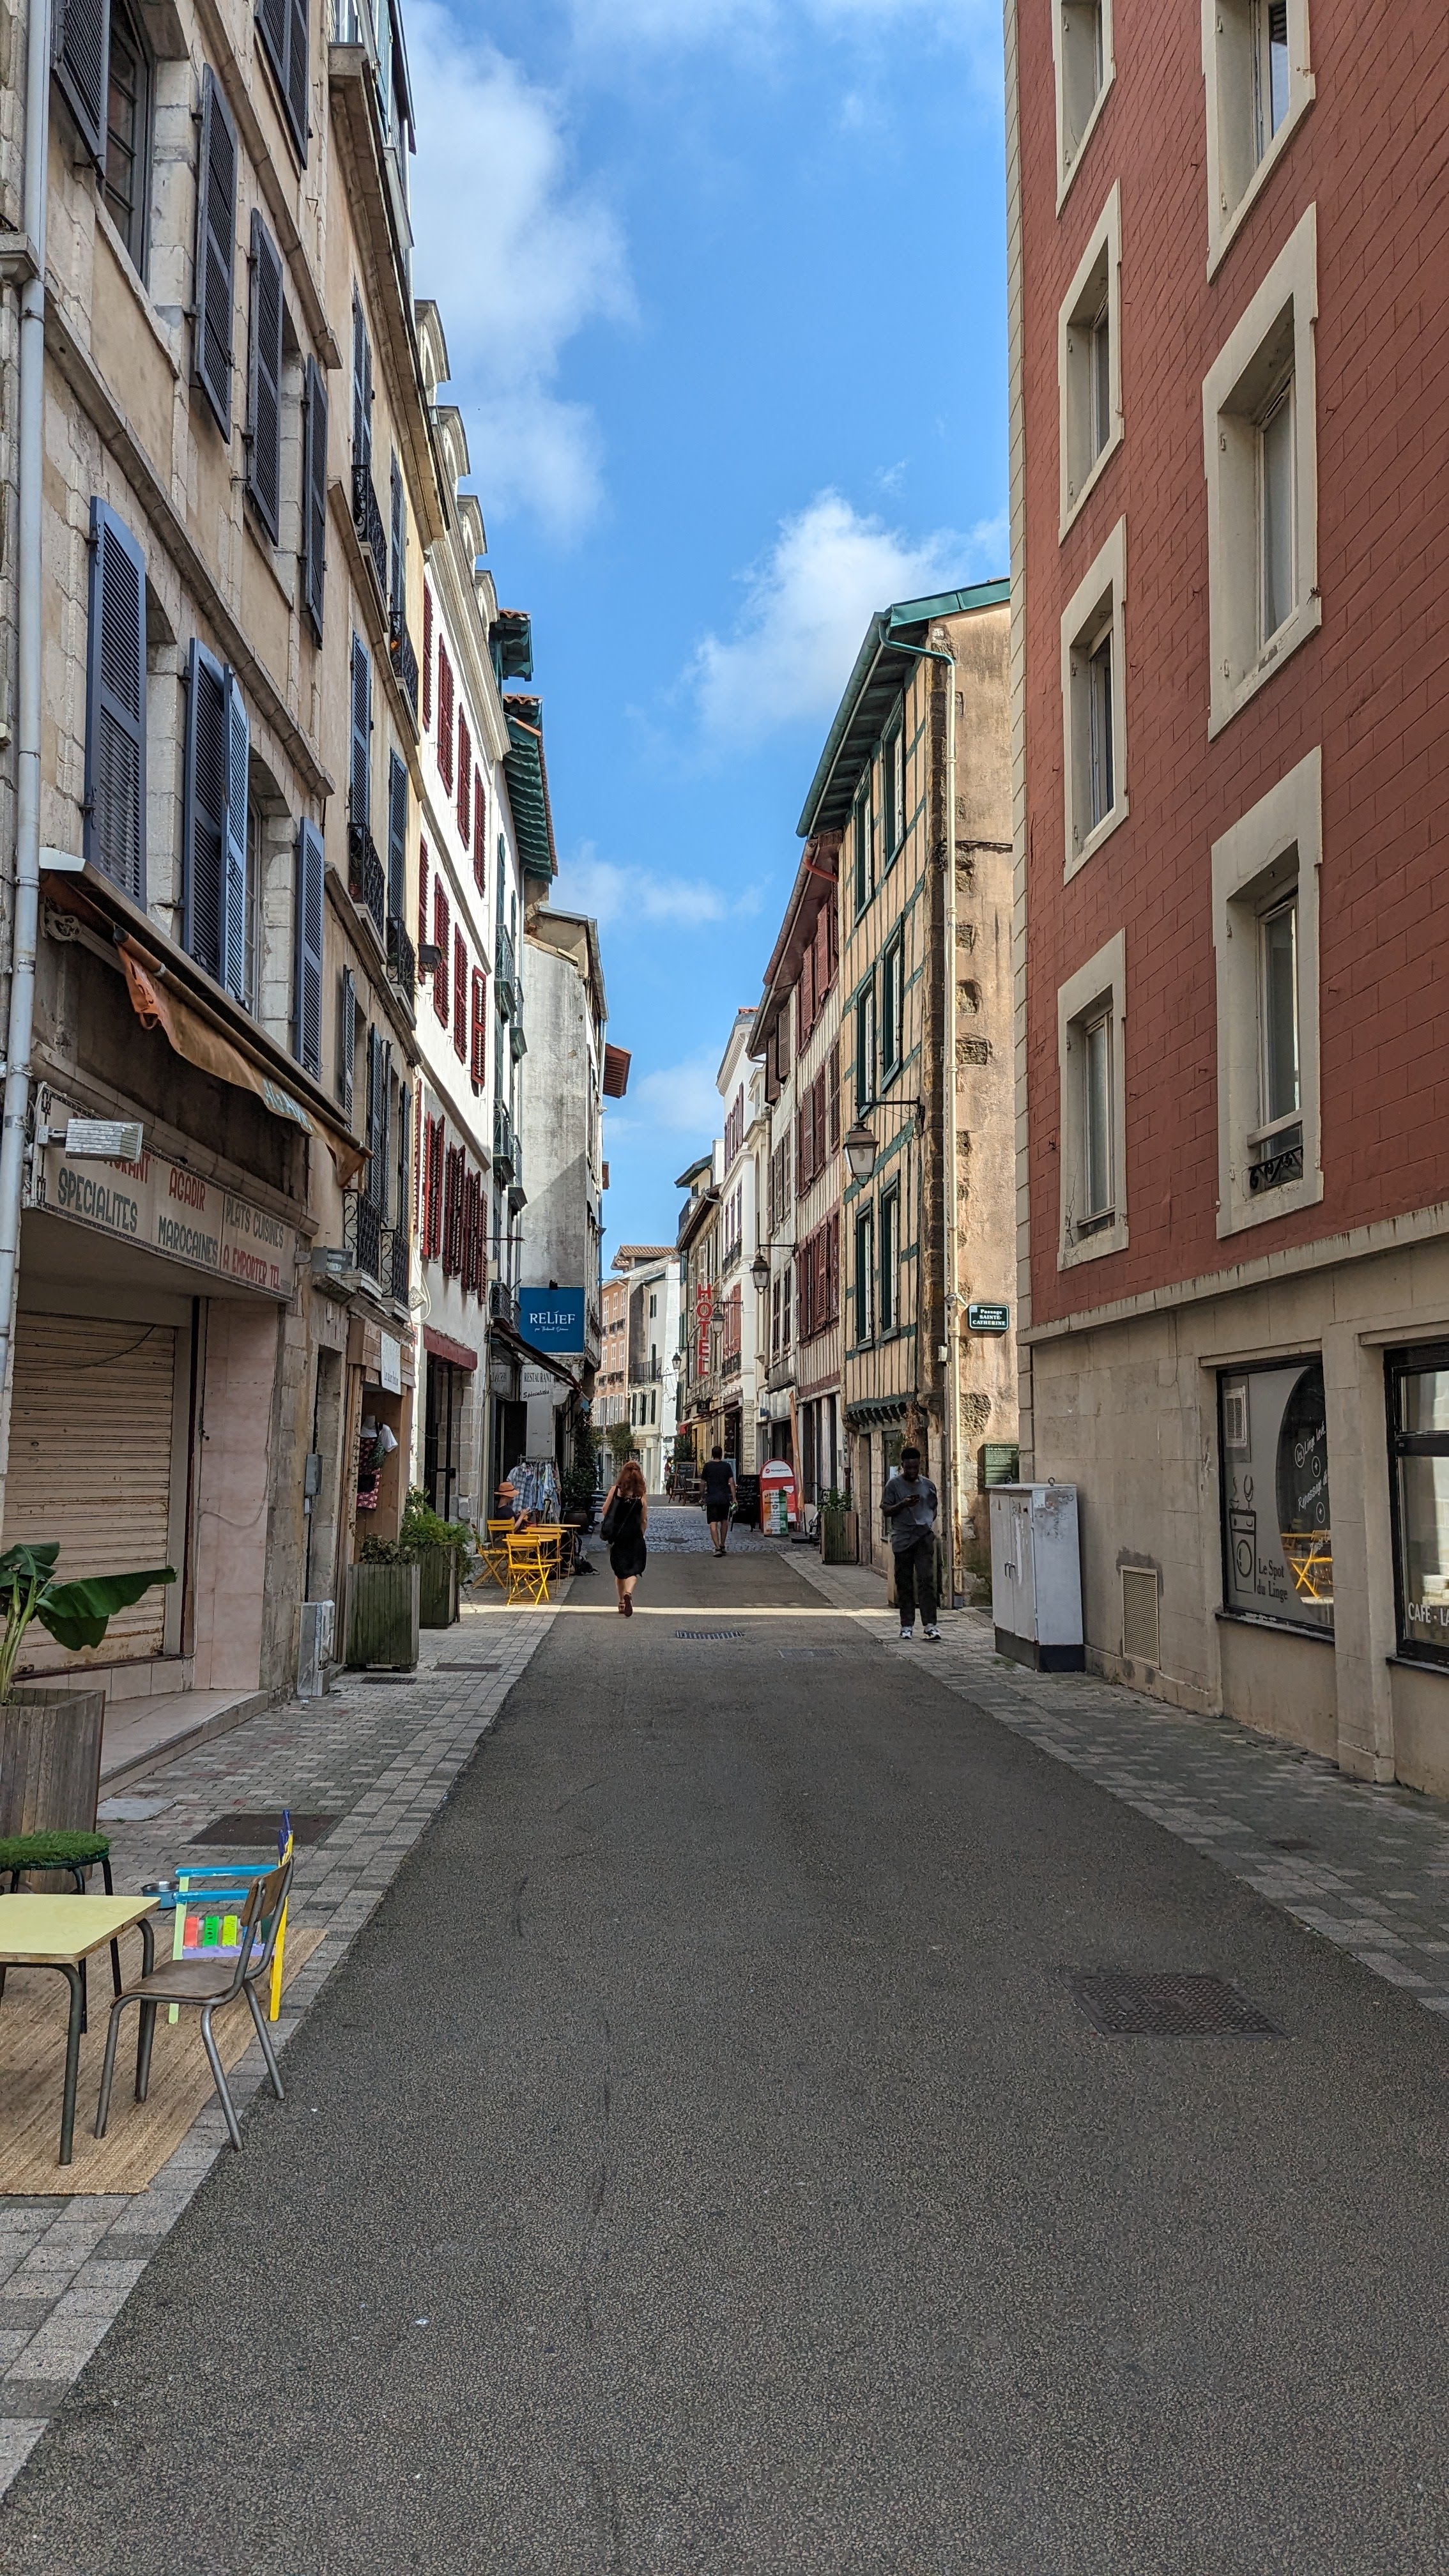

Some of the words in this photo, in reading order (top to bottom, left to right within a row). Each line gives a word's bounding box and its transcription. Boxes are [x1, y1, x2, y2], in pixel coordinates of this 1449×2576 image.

[57, 1167, 138, 1233] SPECIALITES
[158, 1215, 218, 1266] MAROCAINES
[226, 1197, 250, 1233] PLATS
[223, 1244, 230, 1270] A
[232, 1247, 268, 1285] EMPORTER
[270, 1264, 280, 1290] TEL
[696, 1284, 713, 1376] HOTEL
[524, 1372, 551, 1383] RESTAURANT
[1304, 1435, 1315, 1455] Linge
[1298, 1479, 1322, 1512] Repassage
[1258, 1558, 1268, 1575] Le
[1268, 1560, 1285, 1581] Spot
[1256, 1578, 1266, 1595] du
[1268, 1580, 1289, 1603] Linge
[1408, 1602, 1431, 1623] CAFE
